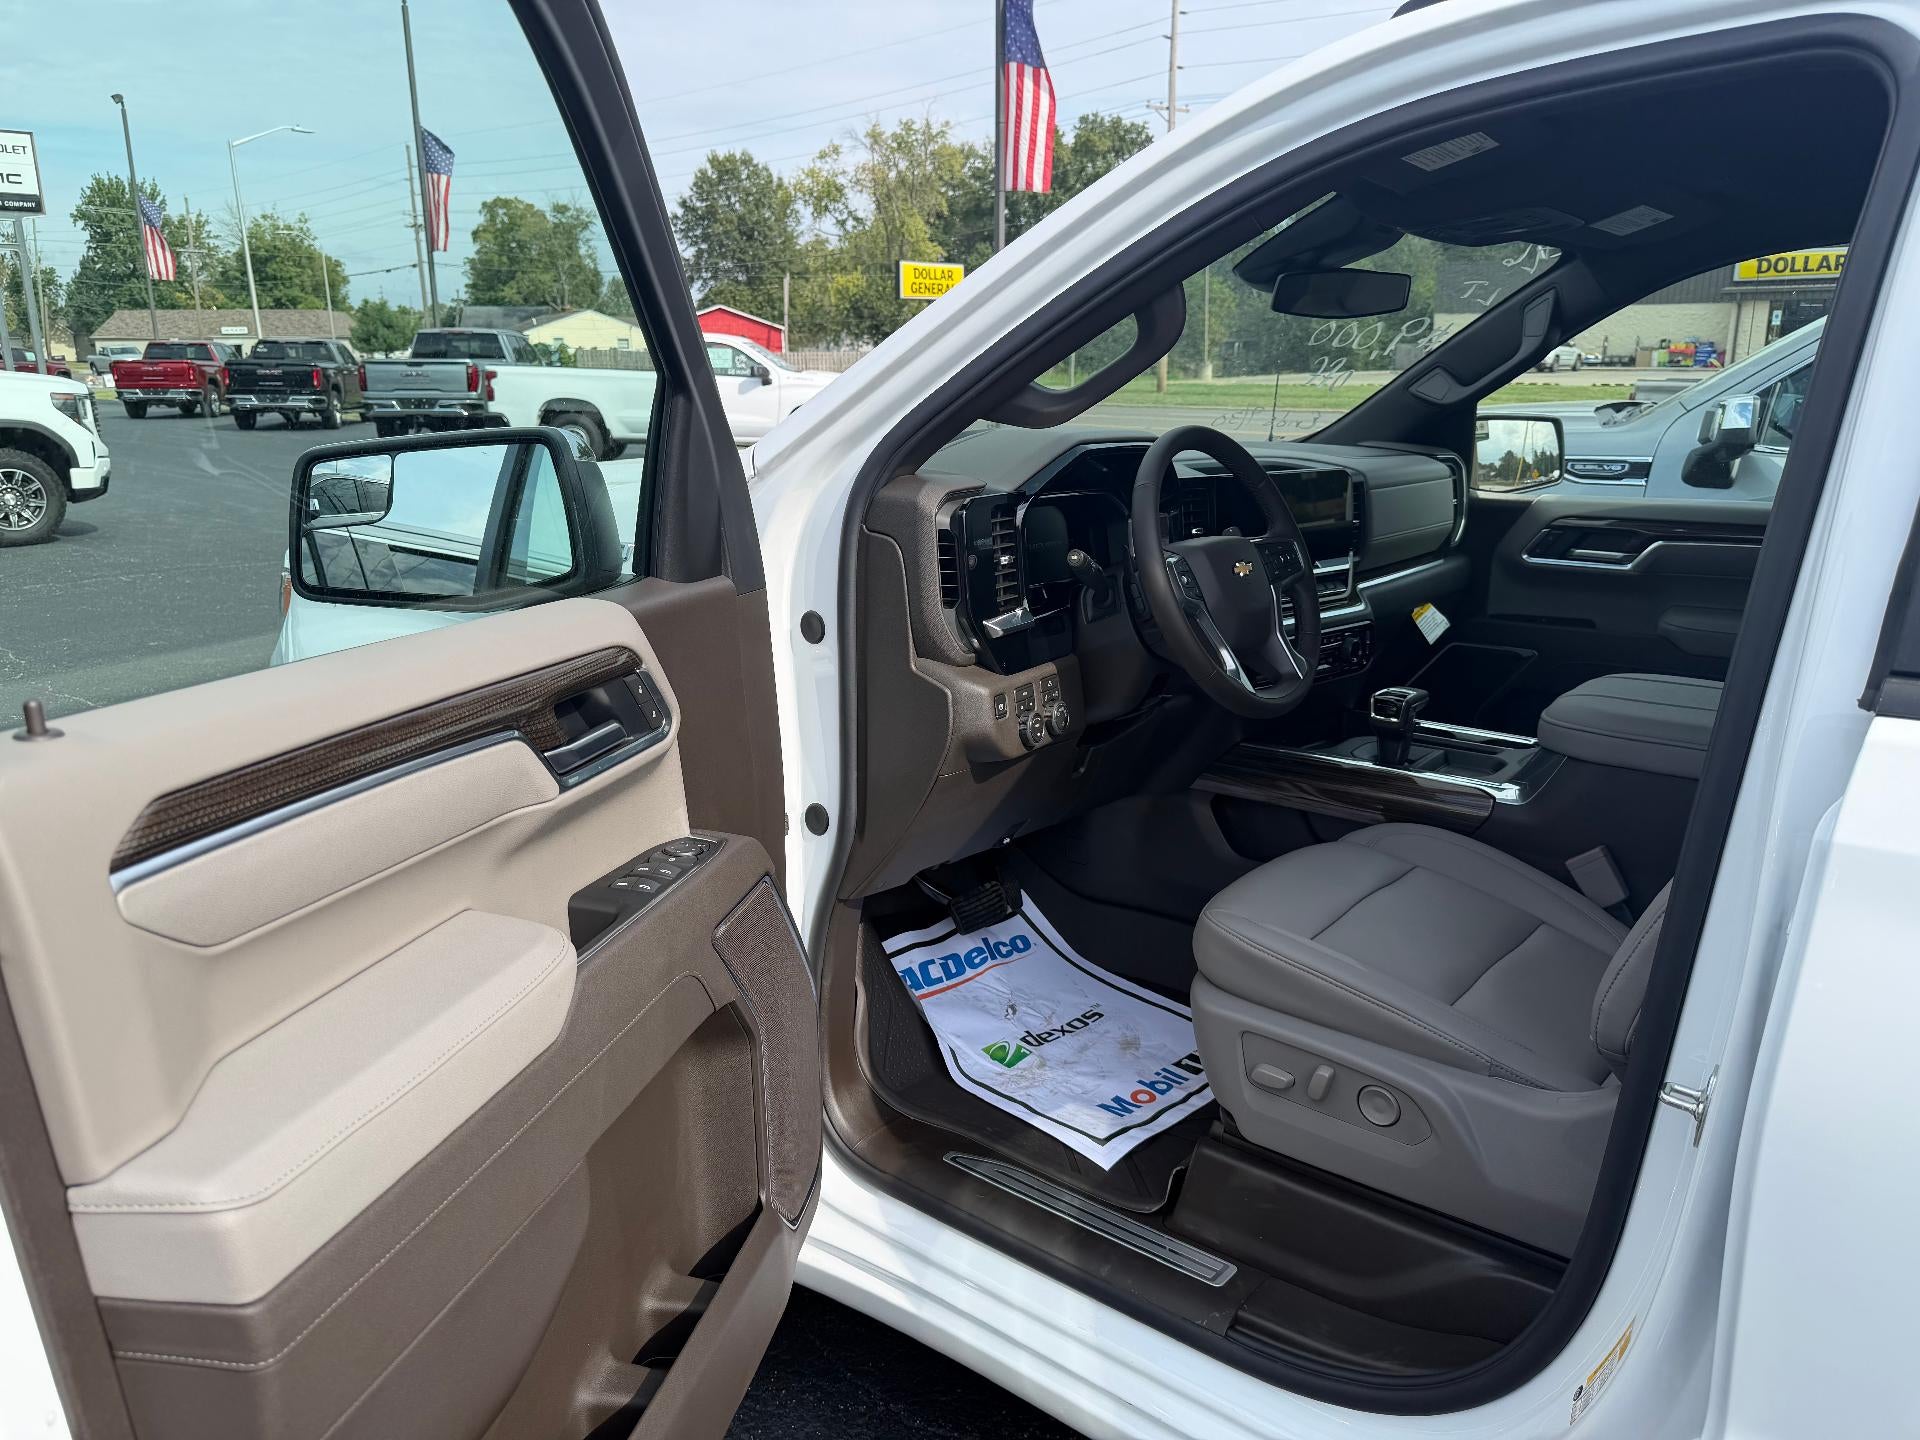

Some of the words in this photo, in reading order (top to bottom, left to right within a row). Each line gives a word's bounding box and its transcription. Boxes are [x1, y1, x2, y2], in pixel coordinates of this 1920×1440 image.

[4, 200, 36, 208] COMPANY
[913, 268, 954, 281] DOLLAR
[911, 282, 954, 295] GENERA
[898, 934, 1032, 992] ACDelco
[1095, 1067, 1190, 1118] Mobil
